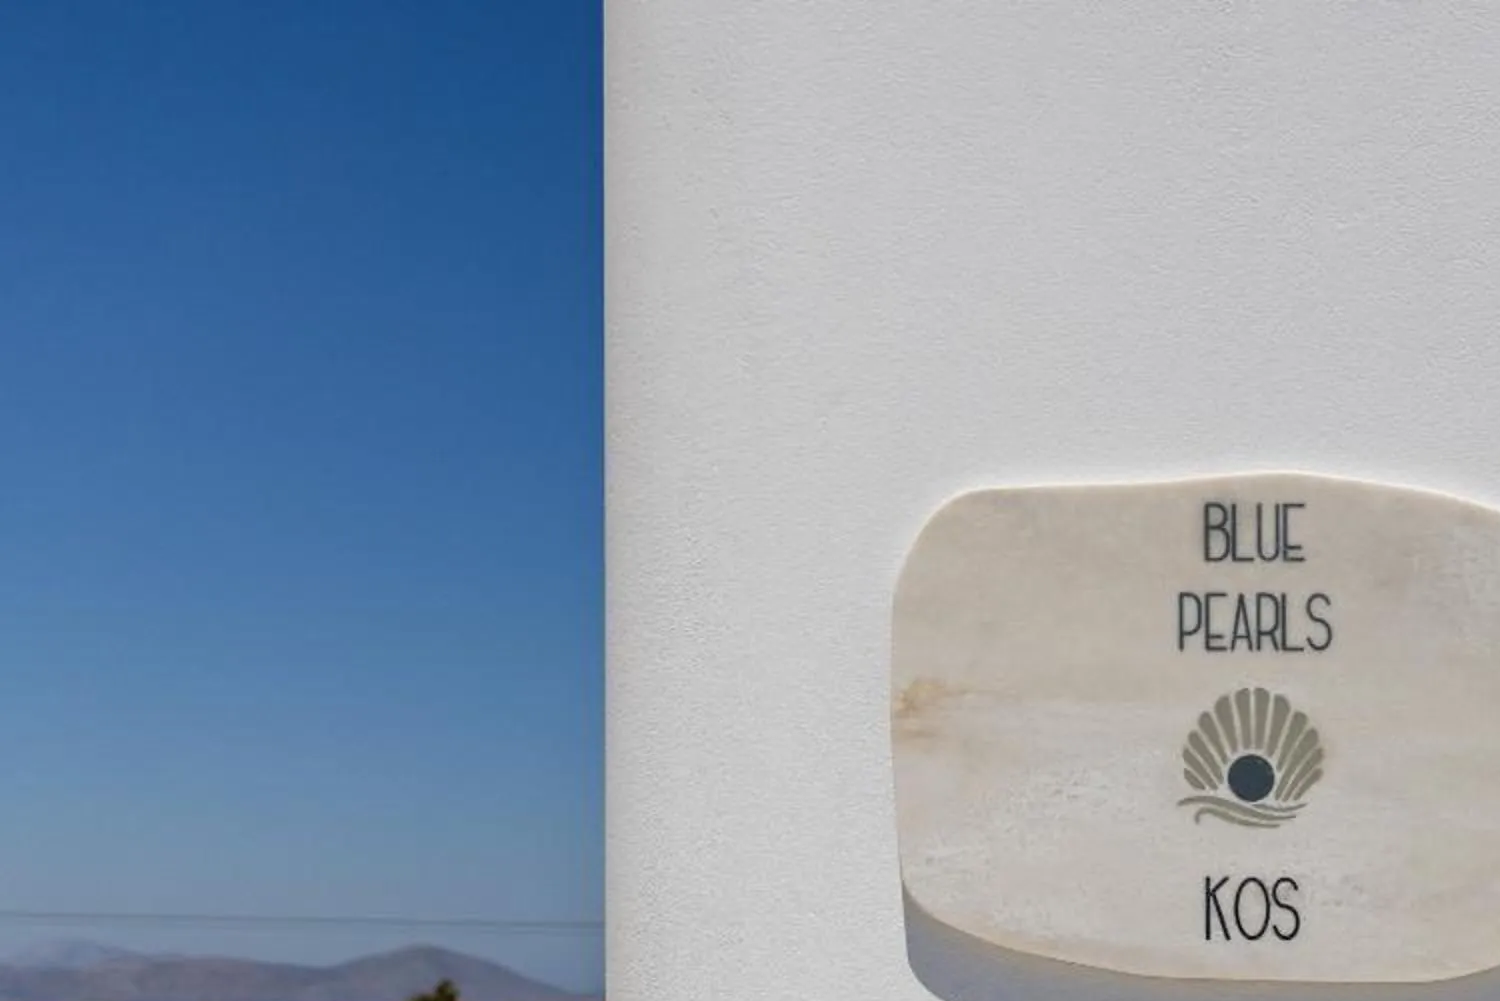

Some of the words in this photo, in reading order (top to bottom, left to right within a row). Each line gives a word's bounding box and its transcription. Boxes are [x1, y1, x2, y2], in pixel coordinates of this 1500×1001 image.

[1202, 500, 1307, 564] BLUE
[1177, 591, 1334, 653] PEARLS
[1204, 875, 1301, 942] KOS
